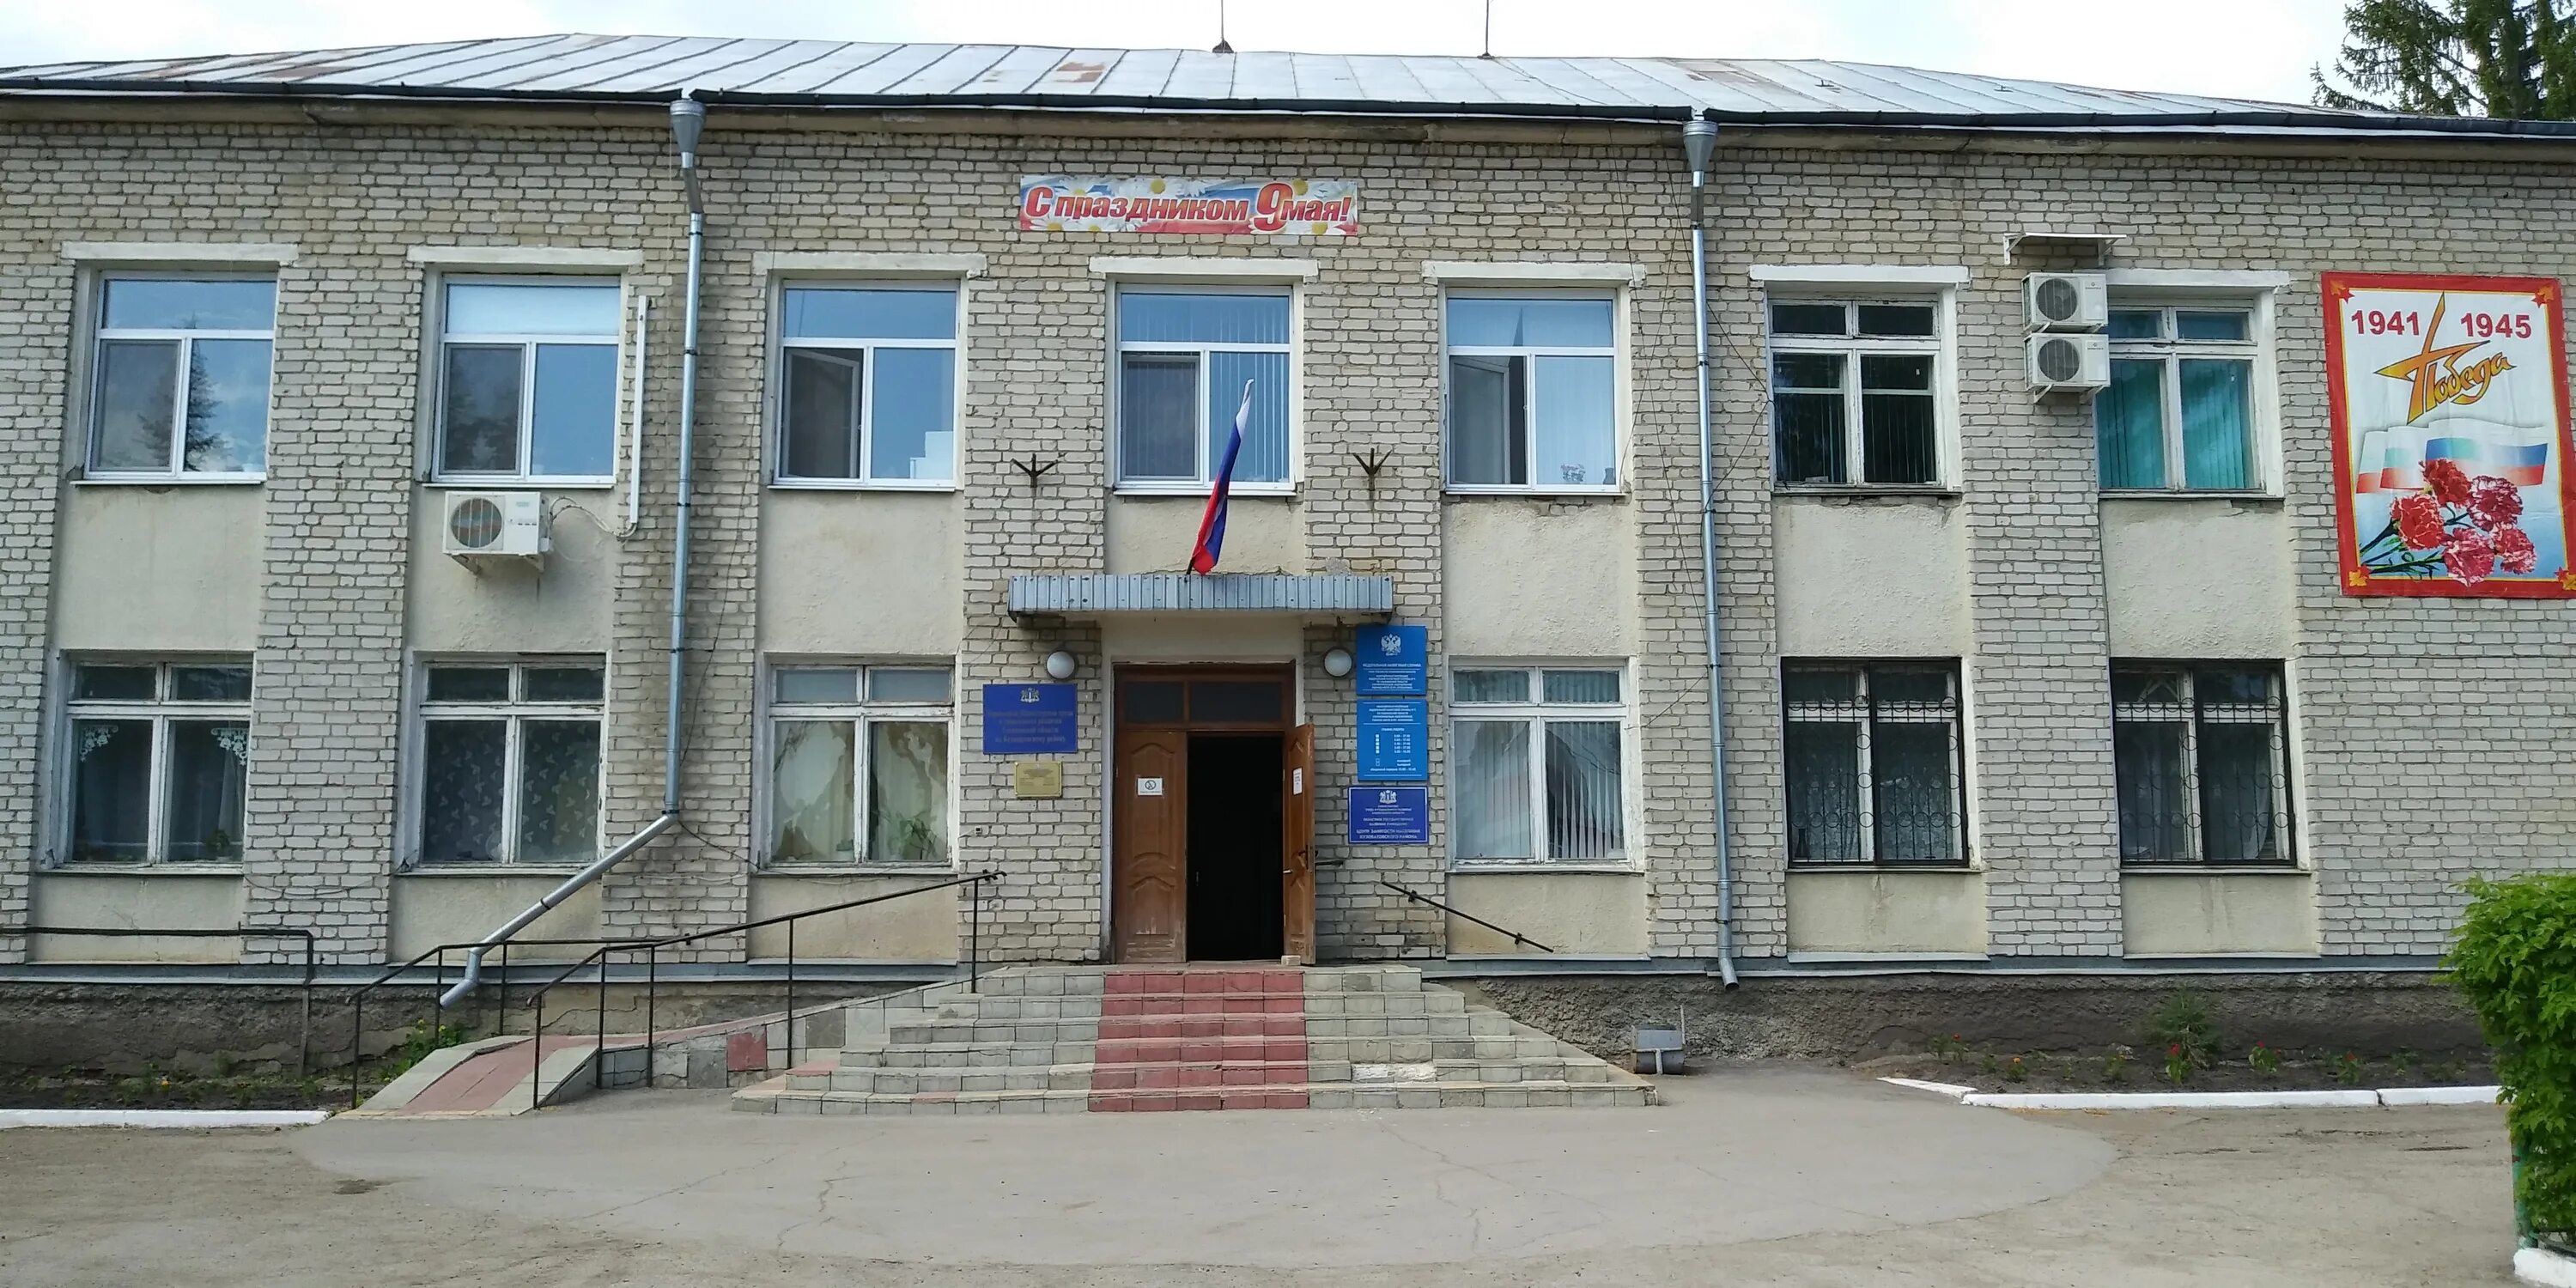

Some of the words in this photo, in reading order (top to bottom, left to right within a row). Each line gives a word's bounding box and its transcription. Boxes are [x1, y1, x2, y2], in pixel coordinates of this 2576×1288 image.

[1025, 185, 1053, 218] С
[1054, 195, 1248, 222] праздником
[1254, 183, 1293, 232] 9
[1281, 196, 1352, 222] мая!
[2351, 310, 2421, 336] 1941
[2460, 313, 2532, 339] 1945
[2373, 339, 2517, 425] Победа
